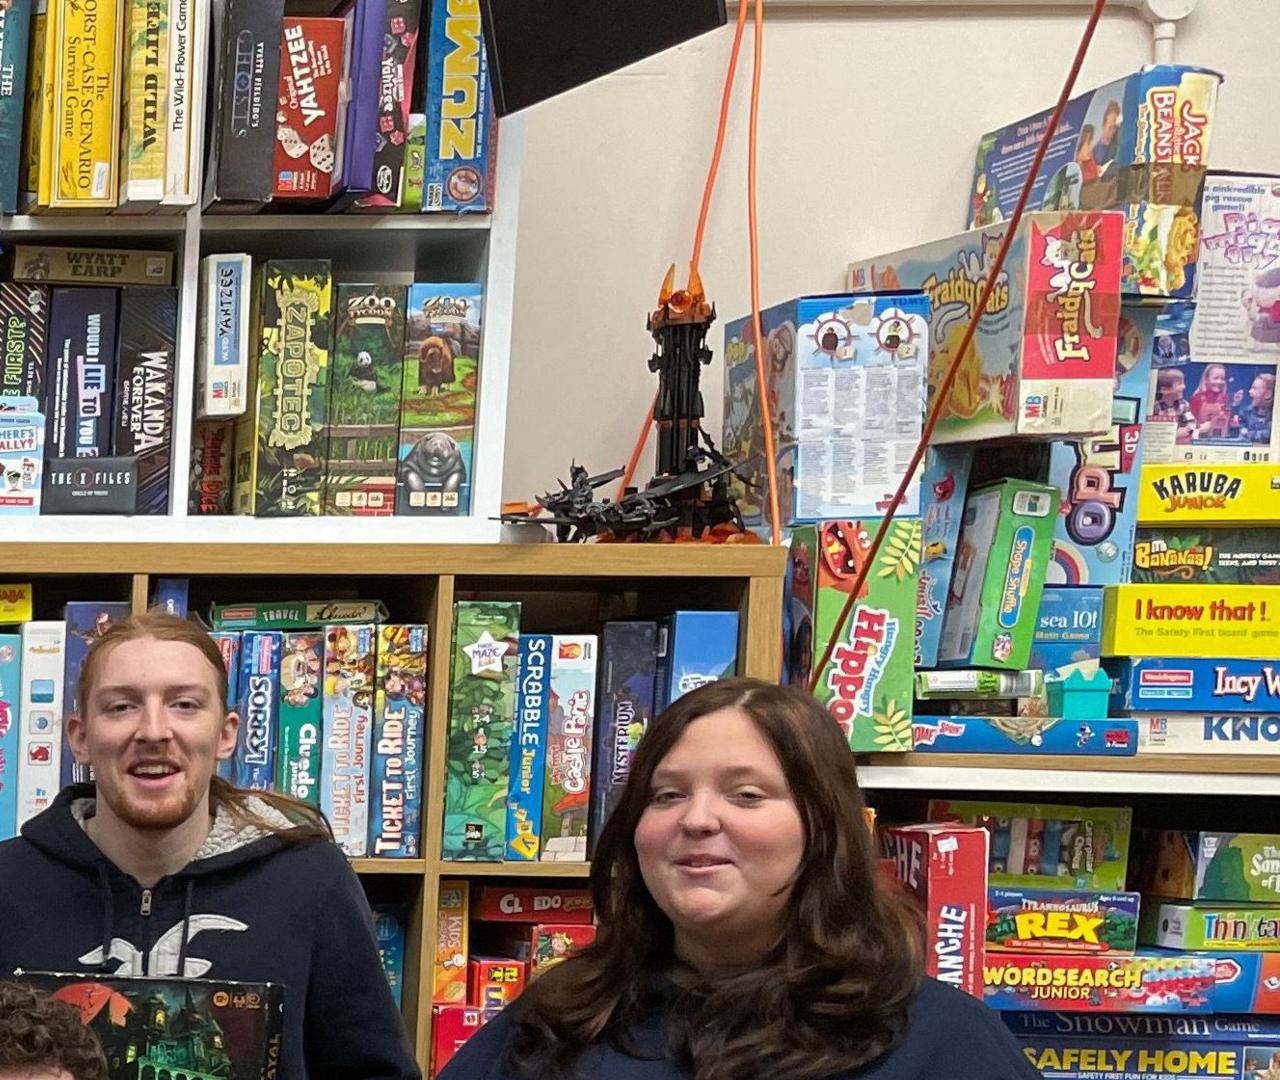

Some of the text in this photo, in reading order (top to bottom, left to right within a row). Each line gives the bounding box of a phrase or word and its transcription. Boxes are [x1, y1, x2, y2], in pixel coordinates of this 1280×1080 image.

[0, 64, 15, 97] THE
[64, 36, 81, 138] Survival Game
[96, 72, 110, 102] The
[142, 1, 161, 151] WILD LIFE
[285, 24, 326, 126] YAHTZEE
[380, 57, 395, 113] Yahtzee
[1181, 100, 1208, 172] JACK
[65, 251, 130, 267] WYATT
[70, 264, 123, 278] EARP
[219, 267, 235, 336] YAHTZEE
[347, 295, 397, 311] ZOO
[423, 295, 470, 311] ZOO
[4, 315, 27, 385] FIRST?
[281, 305, 307, 432] ZAPOTEC
[129, 366, 145, 433] FOREVER
[134, 351, 169, 456] WAKANDA
[51, 472, 72, 485] THE
[95, 472, 131, 485] FILES
[1152, 471, 1242, 501] KARUBA
[1165, 494, 1227, 513] JUNIOR
[1134, 541, 1213, 570] BANANAS!
[263, 610, 300, 623] TRAVEL
[1146, 598, 1204, 622] know
[1209, 599, 1255, 622] that
[1214, 666, 1262, 701] Incy
[328, 704, 353, 750] RIDE
[377, 706, 406, 759] RIDE
[519, 638, 546, 795] SCRABBLE Junior
[298, 722, 317, 800] Cluedo
[375, 778, 405, 855] TICKET
[1014, 912, 1105, 943] REX
[982, 965, 1141, 989] WORDSEARCH
[1030, 985, 1090, 1001] JUNIOR
[1022, 1012, 1260, 1036] The Snowman Game
[1023, 1047, 1237, 1075] SAFELY HOME
[1077, 1072, 1104, 1080] SAFETY
